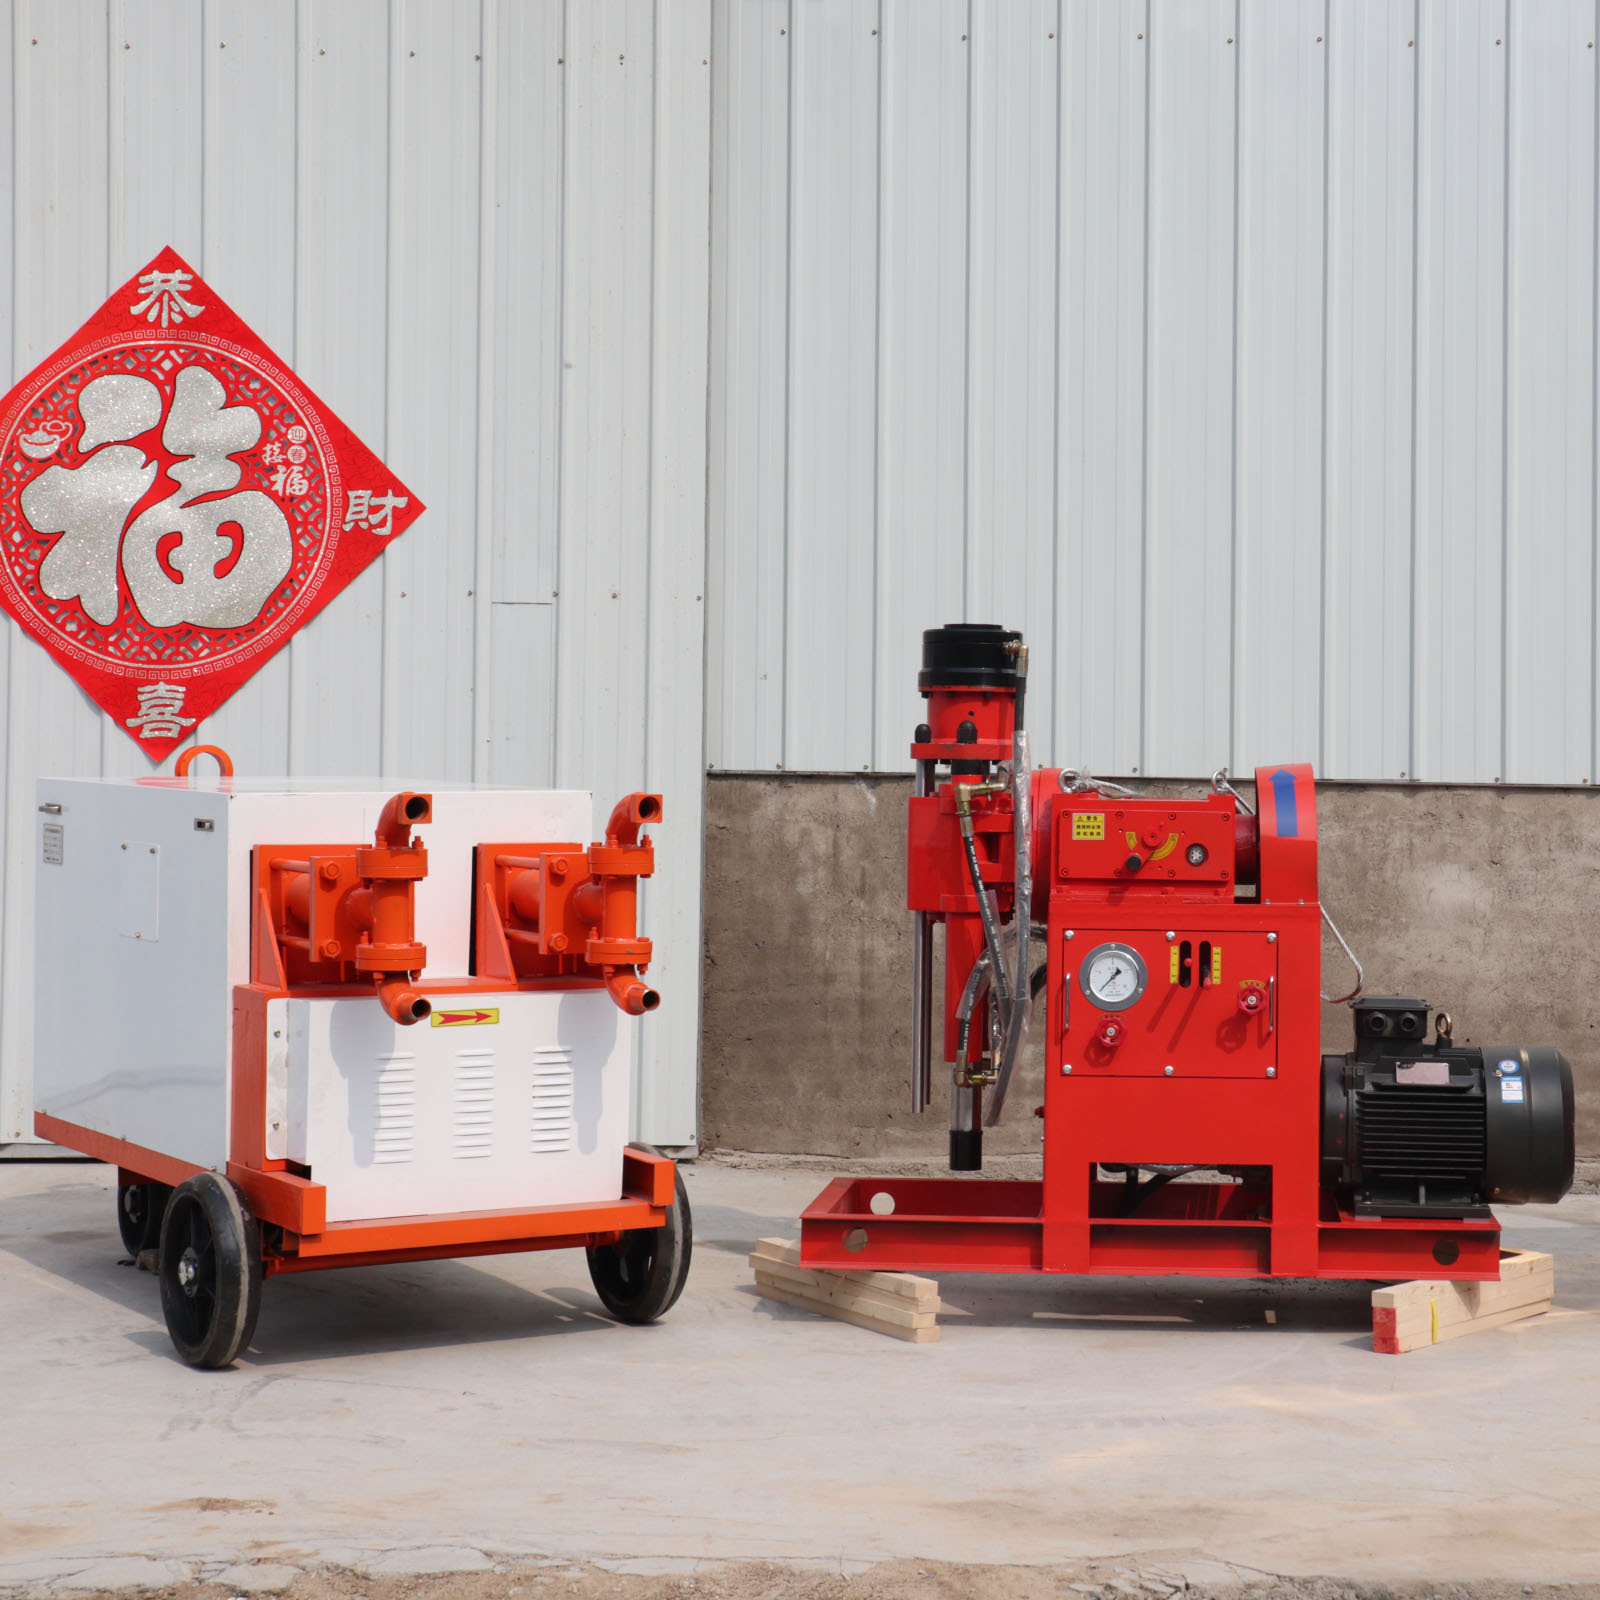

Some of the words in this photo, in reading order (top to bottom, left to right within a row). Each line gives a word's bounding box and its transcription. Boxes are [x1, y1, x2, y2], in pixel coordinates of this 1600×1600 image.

[130, 269, 205, 328] 恭
[20, 365, 293, 630] 福
[342, 489, 408, 536] 財
[126, 681, 196, 739] 喜
